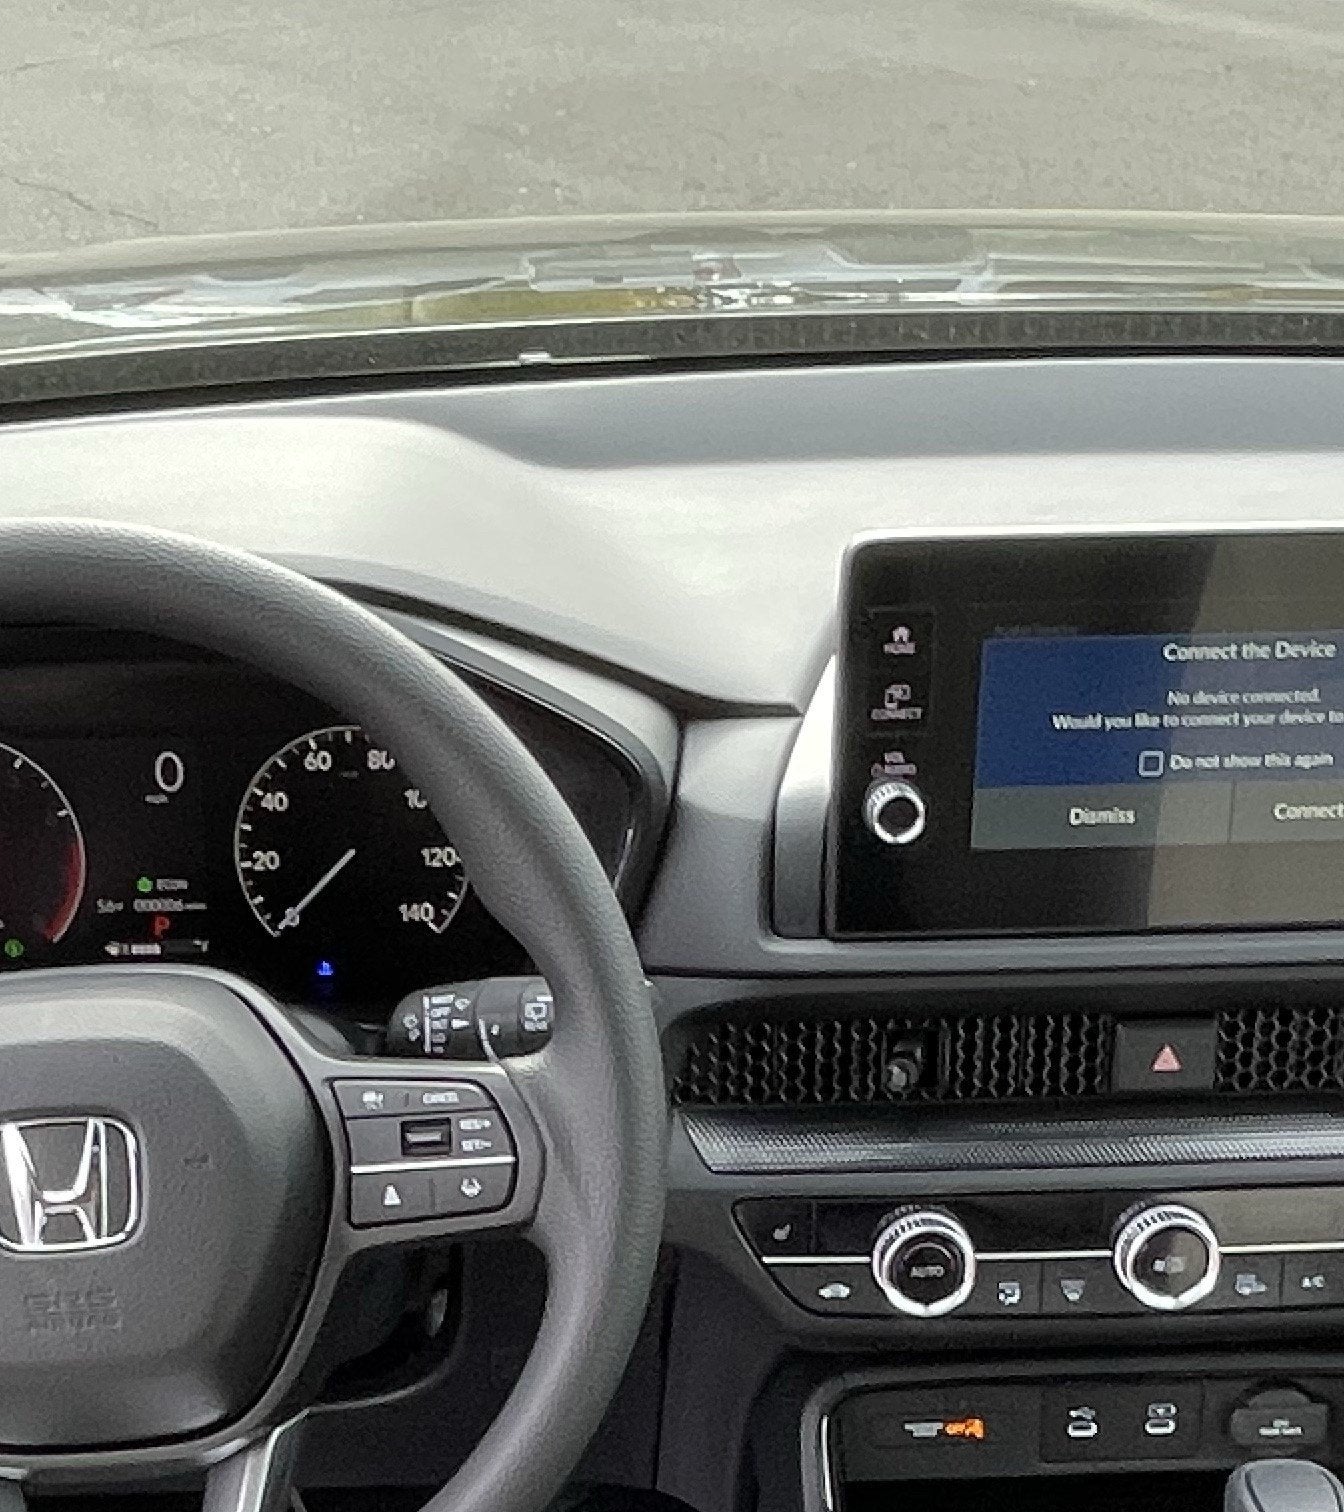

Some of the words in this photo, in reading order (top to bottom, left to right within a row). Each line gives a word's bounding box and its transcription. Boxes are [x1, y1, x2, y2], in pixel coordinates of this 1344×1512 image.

[1163, 643, 1238, 661] Connect
[1243, 642, 1271, 659] the
[1275, 640, 1337, 659] Device
[1167, 691, 1189, 706] No
[1192, 690, 1240, 706] device
[871, 708, 922, 720] CONNECT
[1052, 714, 1102, 730] Would
[1104, 716, 1132, 731] you
[1134, 712, 1160, 729] like
[1163, 712, 1179, 728] to
[1181, 712, 1240, 729] connect
[1243, 713, 1275, 730] your
[1278, 709, 1326, 726] device
[1328, 709, 1344, 724] to
[155, 751, 184, 792] 0
[304, 751, 332, 771] 60
[1170, 754, 1193, 770] Do
[1195, 753, 1220, 769] not
[1222, 753, 1262, 769] show
[1264, 751, 1292, 767] this
[1294, 753, 1334, 771] again
[260, 791, 289, 812] 40
[1069, 807, 1136, 826] Dismiss
[252, 850, 281, 871] 20
[421, 846, 457, 867] 120
[399, 901, 435, 922] 140
[155, 915, 171, 939] P
[910, 1264, 946, 1279] AUTO
